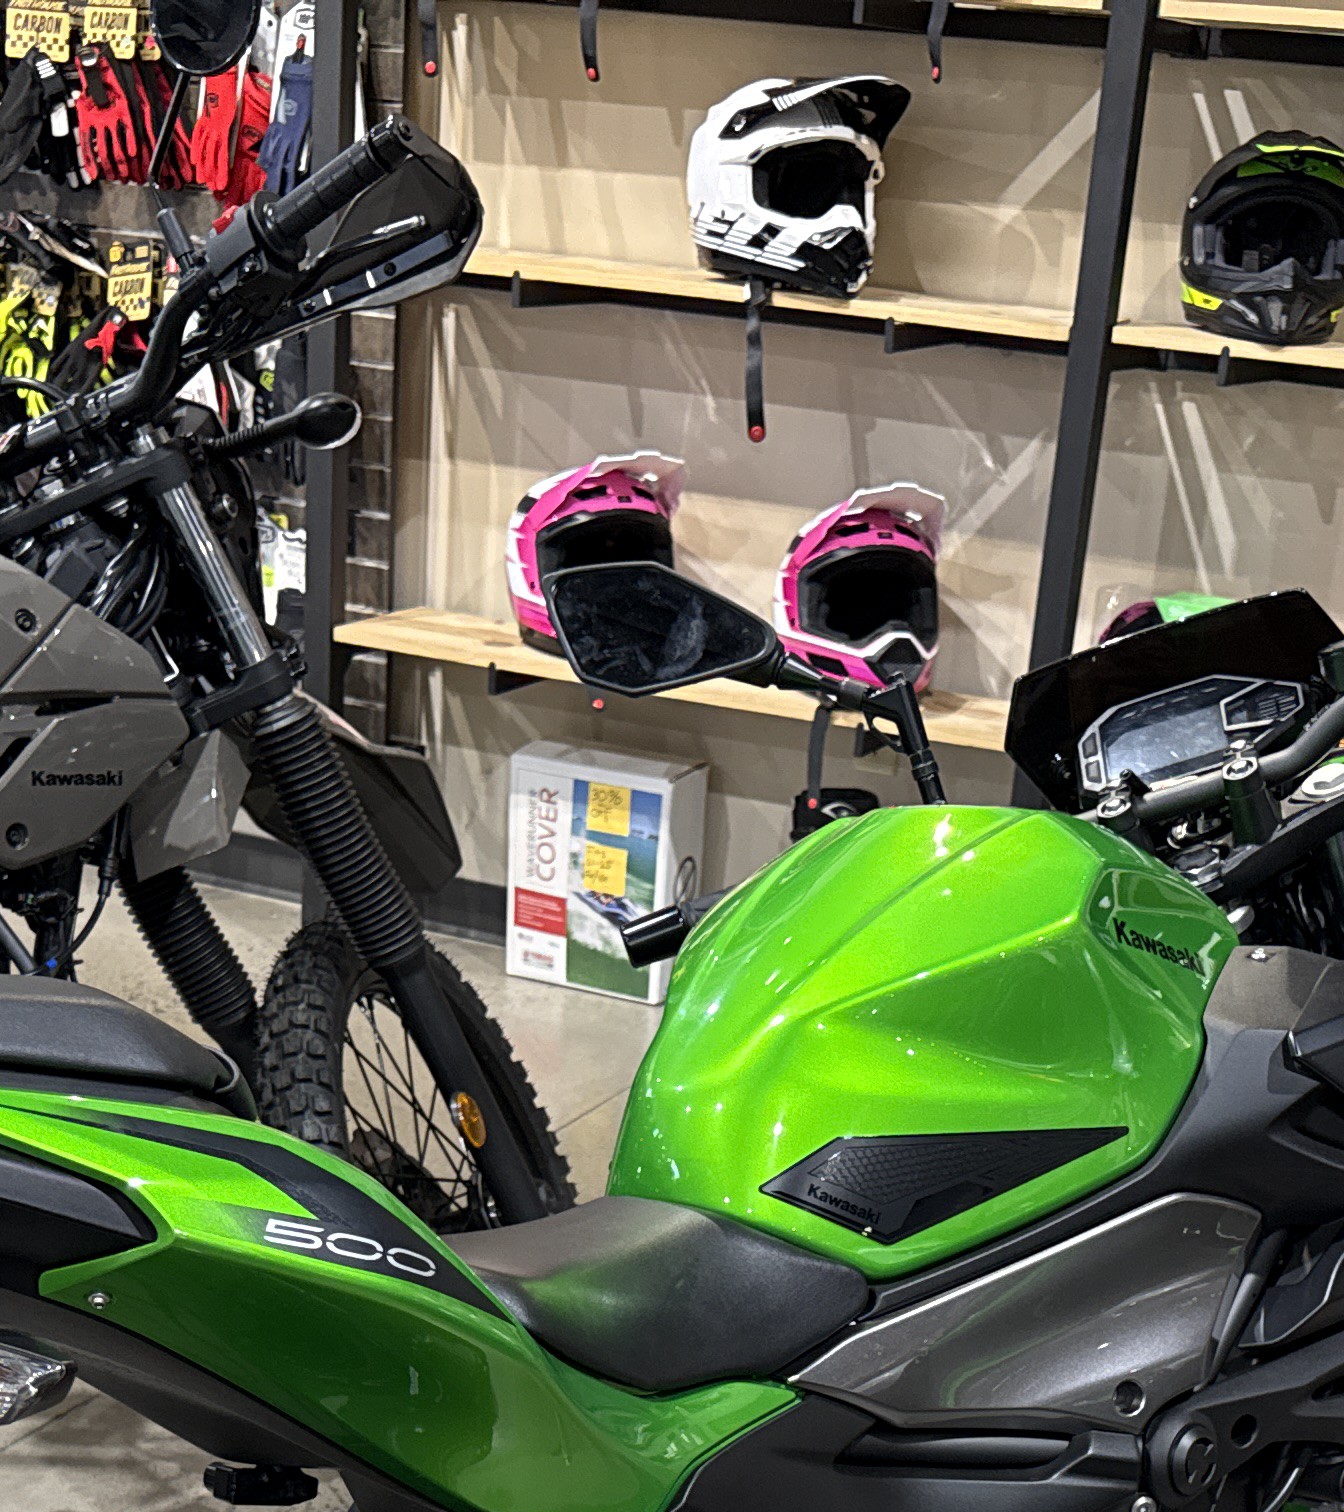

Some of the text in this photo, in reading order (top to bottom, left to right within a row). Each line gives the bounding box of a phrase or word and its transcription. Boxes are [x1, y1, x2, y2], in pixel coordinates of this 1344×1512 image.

[13, 13, 62, 33] CARBON
[31, 769, 124, 787] Kawasaki
[536, 787, 560, 882] COVER
[1112, 916, 1207, 978] Kawasaki
[807, 1183, 882, 1225] Kawasaki
[263, 1217, 437, 1278] 500
